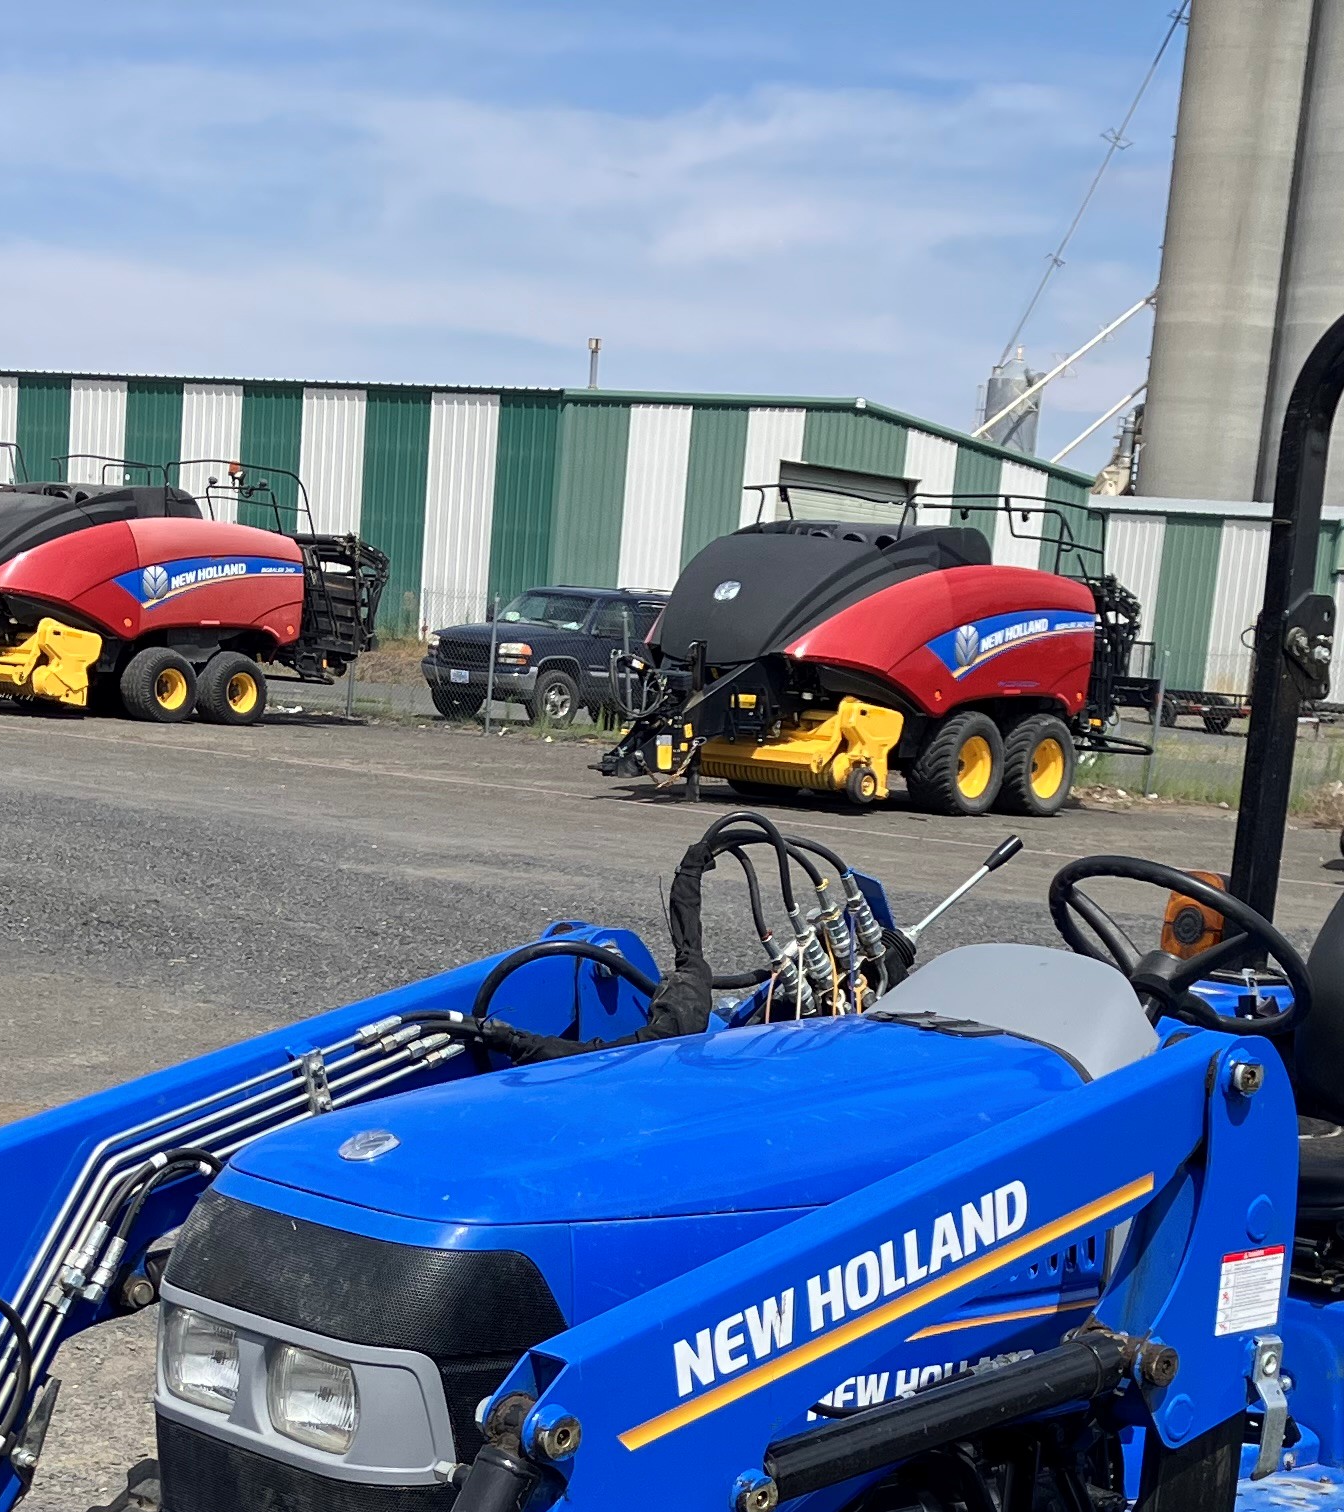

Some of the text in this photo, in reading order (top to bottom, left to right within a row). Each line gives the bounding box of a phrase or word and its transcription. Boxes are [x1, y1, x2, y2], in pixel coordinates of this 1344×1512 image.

[171, 562, 247, 589] NEW HOLLAND
[980, 633, 1005, 653] NEW
[1004, 618, 1049, 642] HOLLAND
[672, 1180, 1029, 1399] NEW HOLLAND
